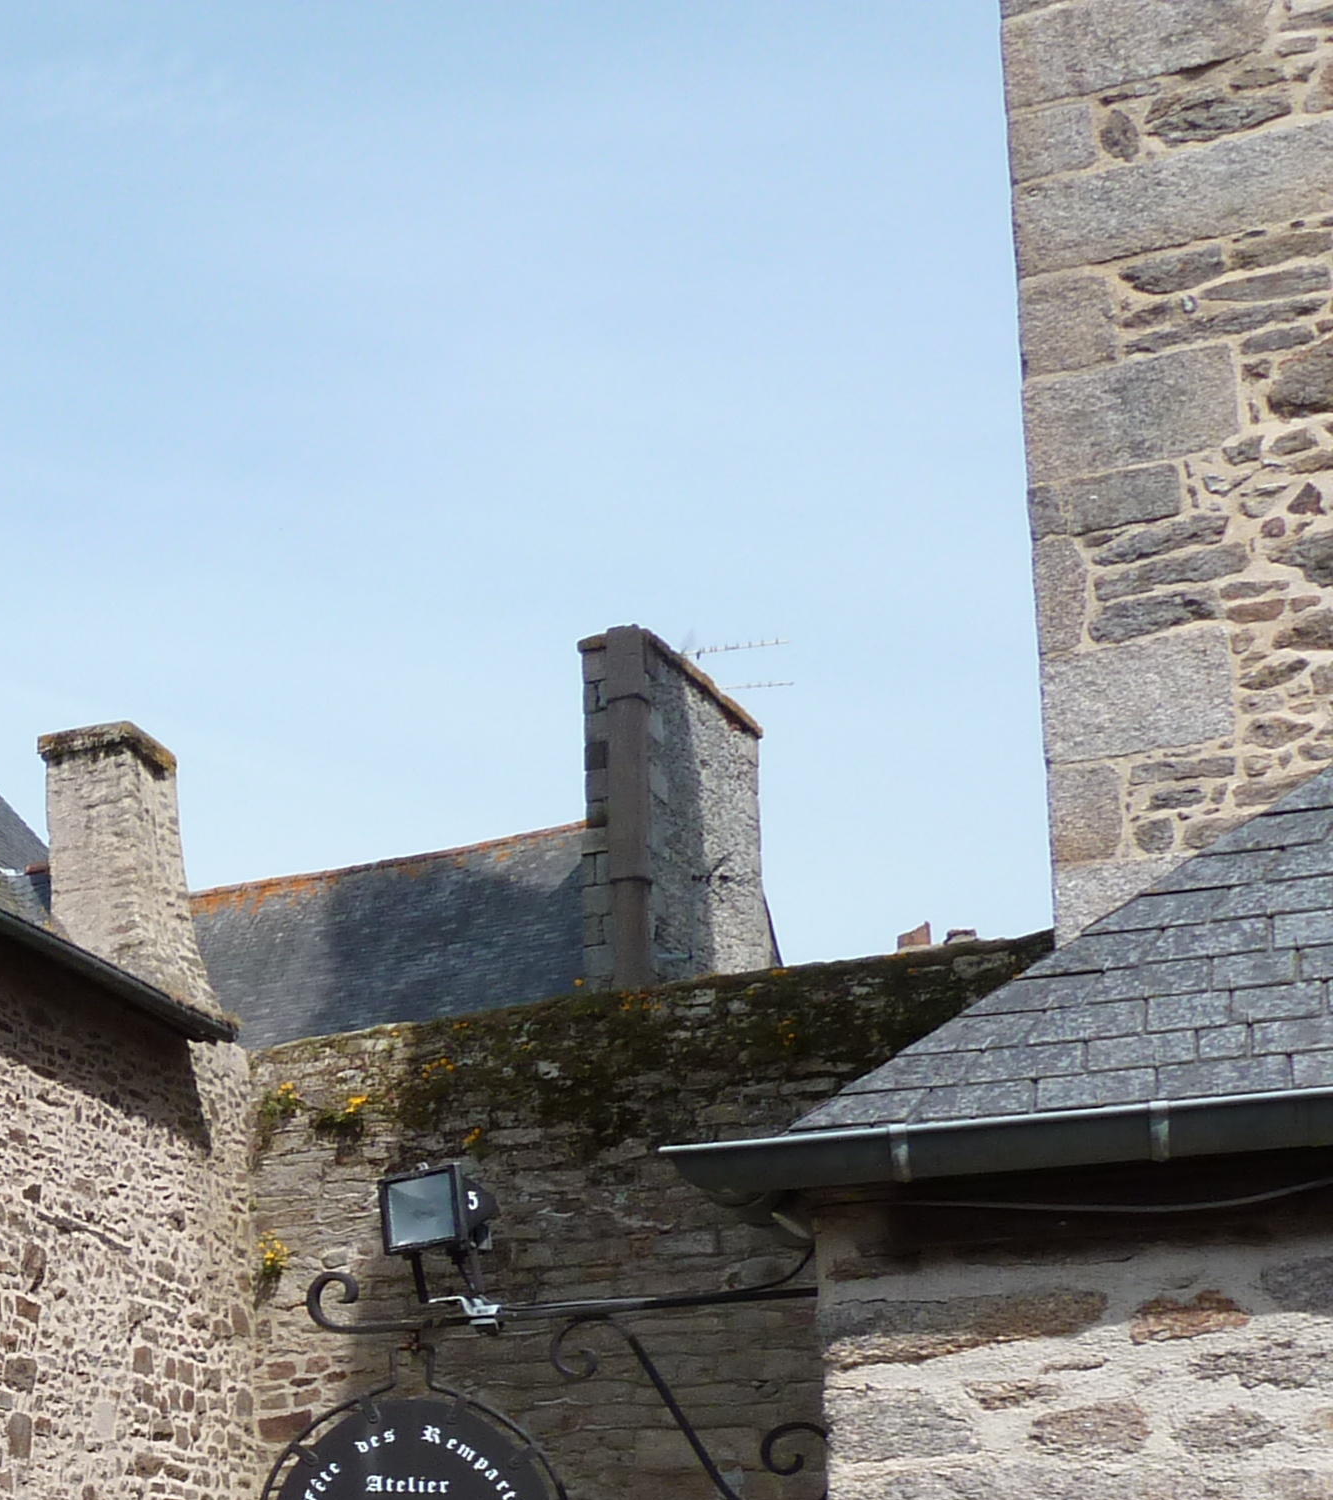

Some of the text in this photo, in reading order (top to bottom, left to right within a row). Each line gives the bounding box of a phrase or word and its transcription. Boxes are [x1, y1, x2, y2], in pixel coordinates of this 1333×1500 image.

[467, 1190, 479, 1211] 5
[354, 1428, 396, 1454] des
[365, 1474, 450, 1494] Atelier
